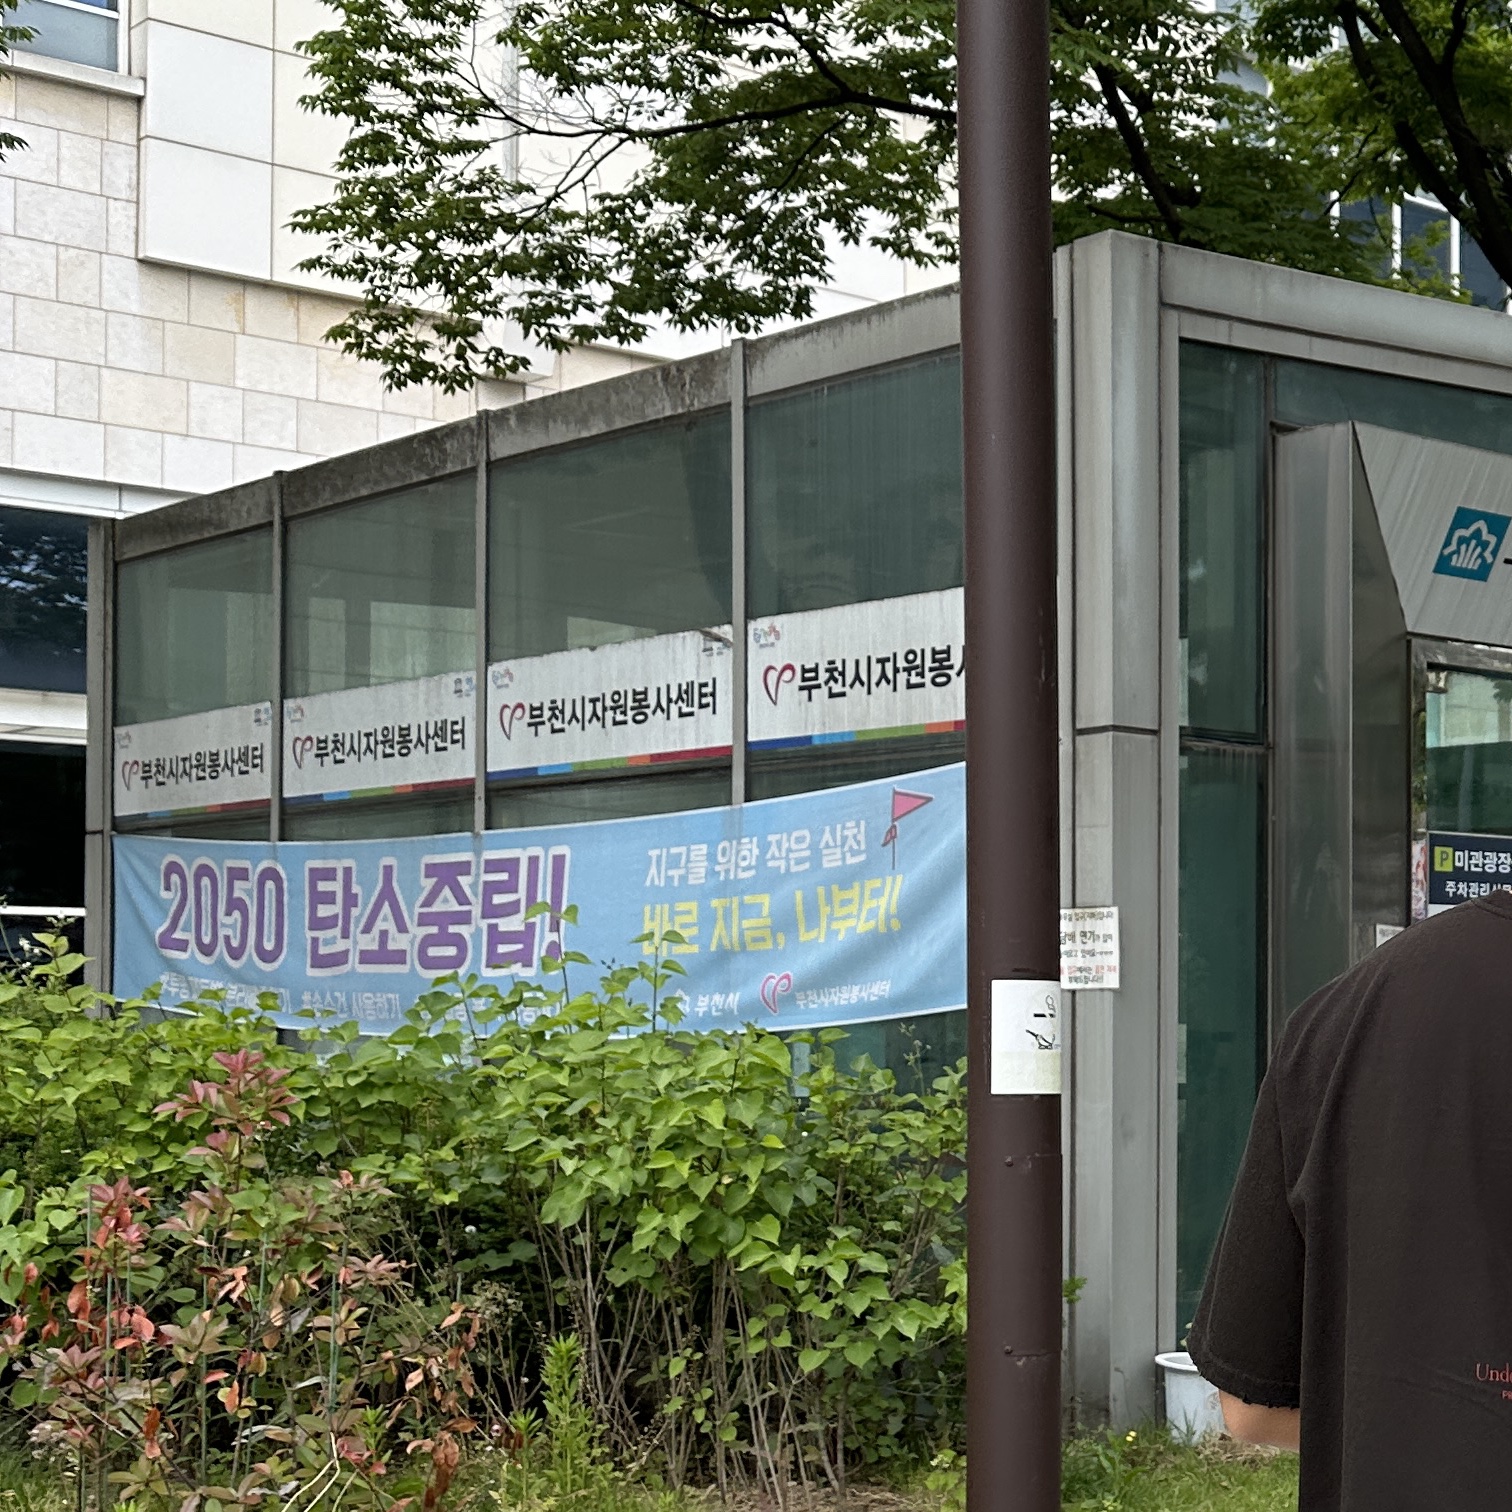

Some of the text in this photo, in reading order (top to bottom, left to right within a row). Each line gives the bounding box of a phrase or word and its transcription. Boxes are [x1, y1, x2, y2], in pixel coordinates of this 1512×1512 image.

[527, 677, 717, 737] 부천시자원봉사센터
[140, 742, 264, 789] 부천시자원봉사센터
[314, 716, 465, 767] 부천시자원봉사센터
[644, 820, 867, 888] 지구를 위한 작은 실천
[156, 846, 570, 977] 2050 탄소중립!
[641, 874, 903, 957] 바로 지금, 나부터!
[694, 991, 742, 1017] 부천시
